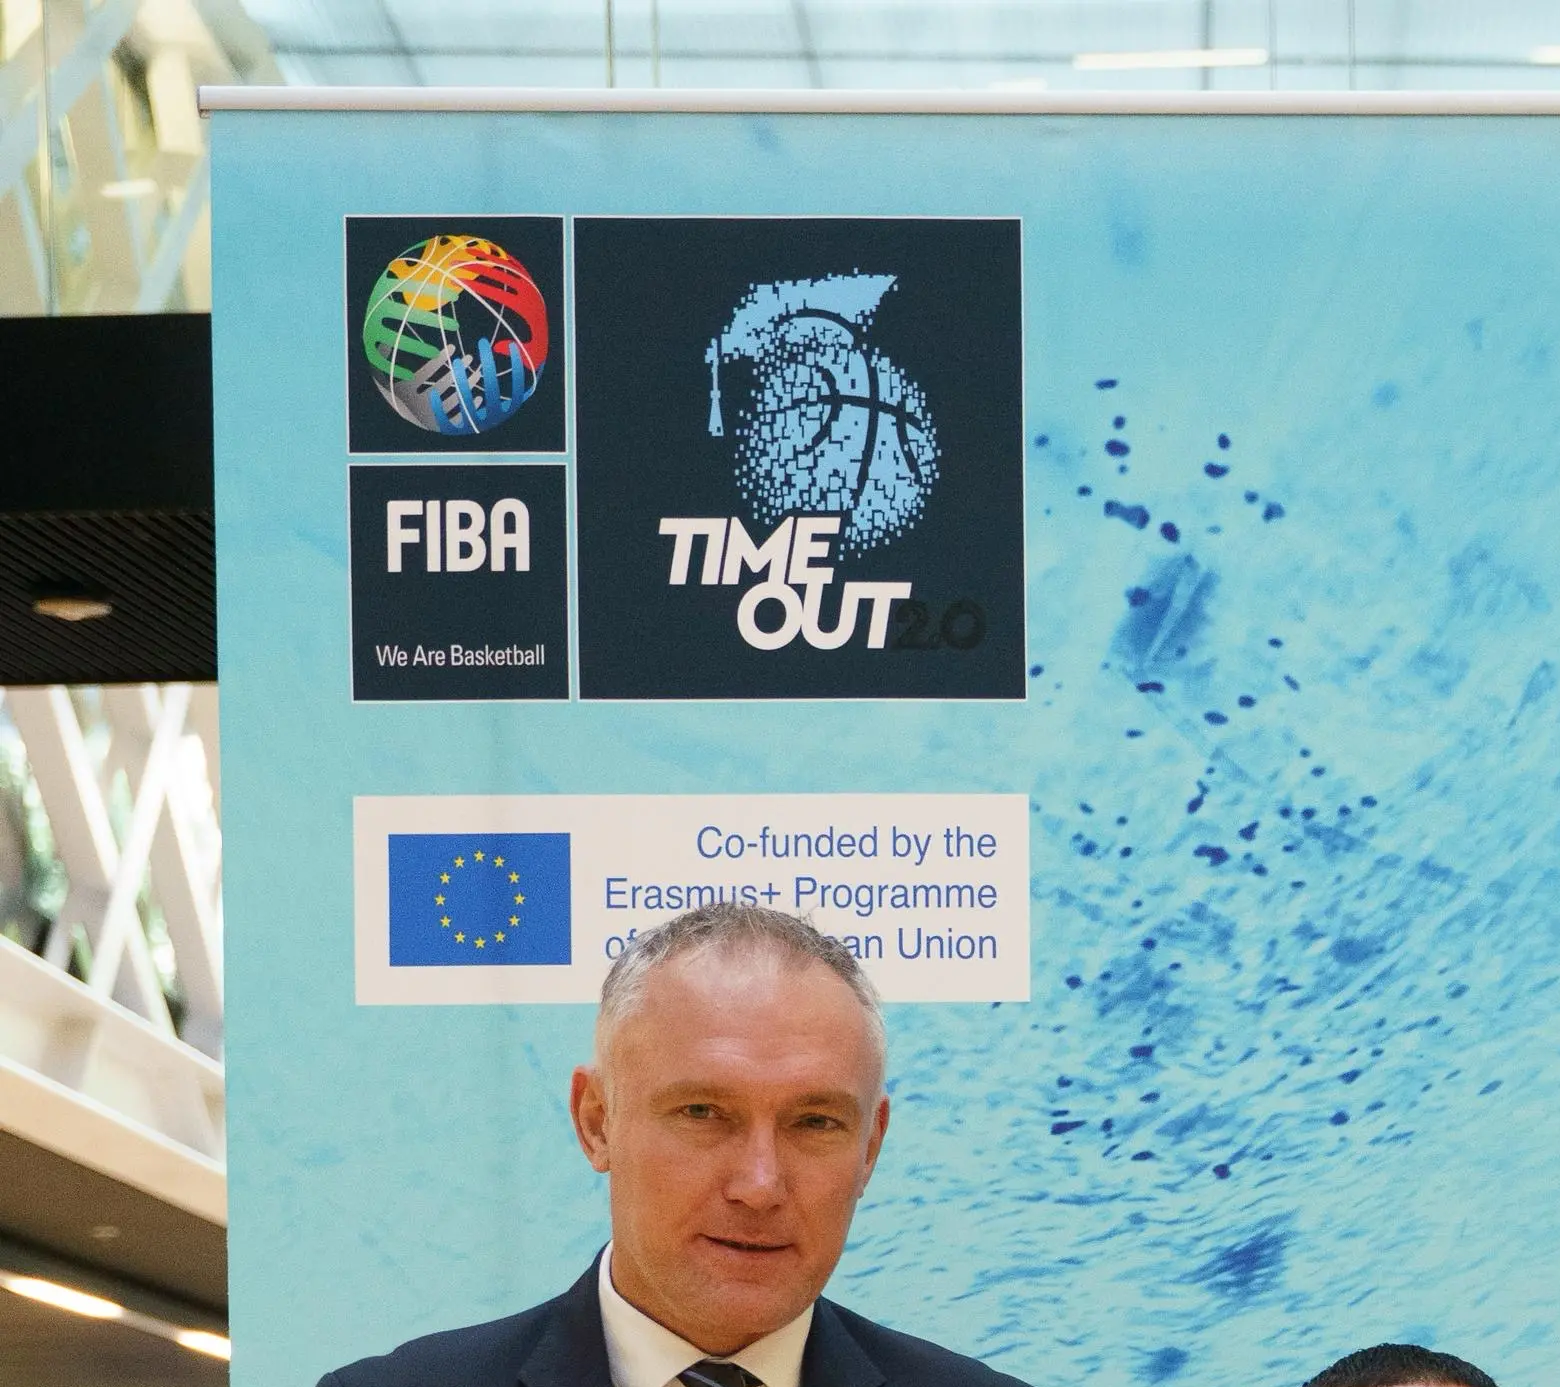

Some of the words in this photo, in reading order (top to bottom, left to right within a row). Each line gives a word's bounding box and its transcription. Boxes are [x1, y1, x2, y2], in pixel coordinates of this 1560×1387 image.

[386, 498, 530, 573] FIBA
[658, 516, 841, 585] TIME
[736, 580, 913, 651] OUT
[375, 645, 408, 666] We
[412, 644, 446, 666] Are
[450, 644, 545, 666] Basketball
[696, 825, 879, 859] Co-funded
[891, 825, 932, 866] by
[943, 825, 998, 859] the
[605, 877, 782, 910] Erasmus+
[794, 876, 998, 917] Programme
[897, 927, 998, 960] Union
